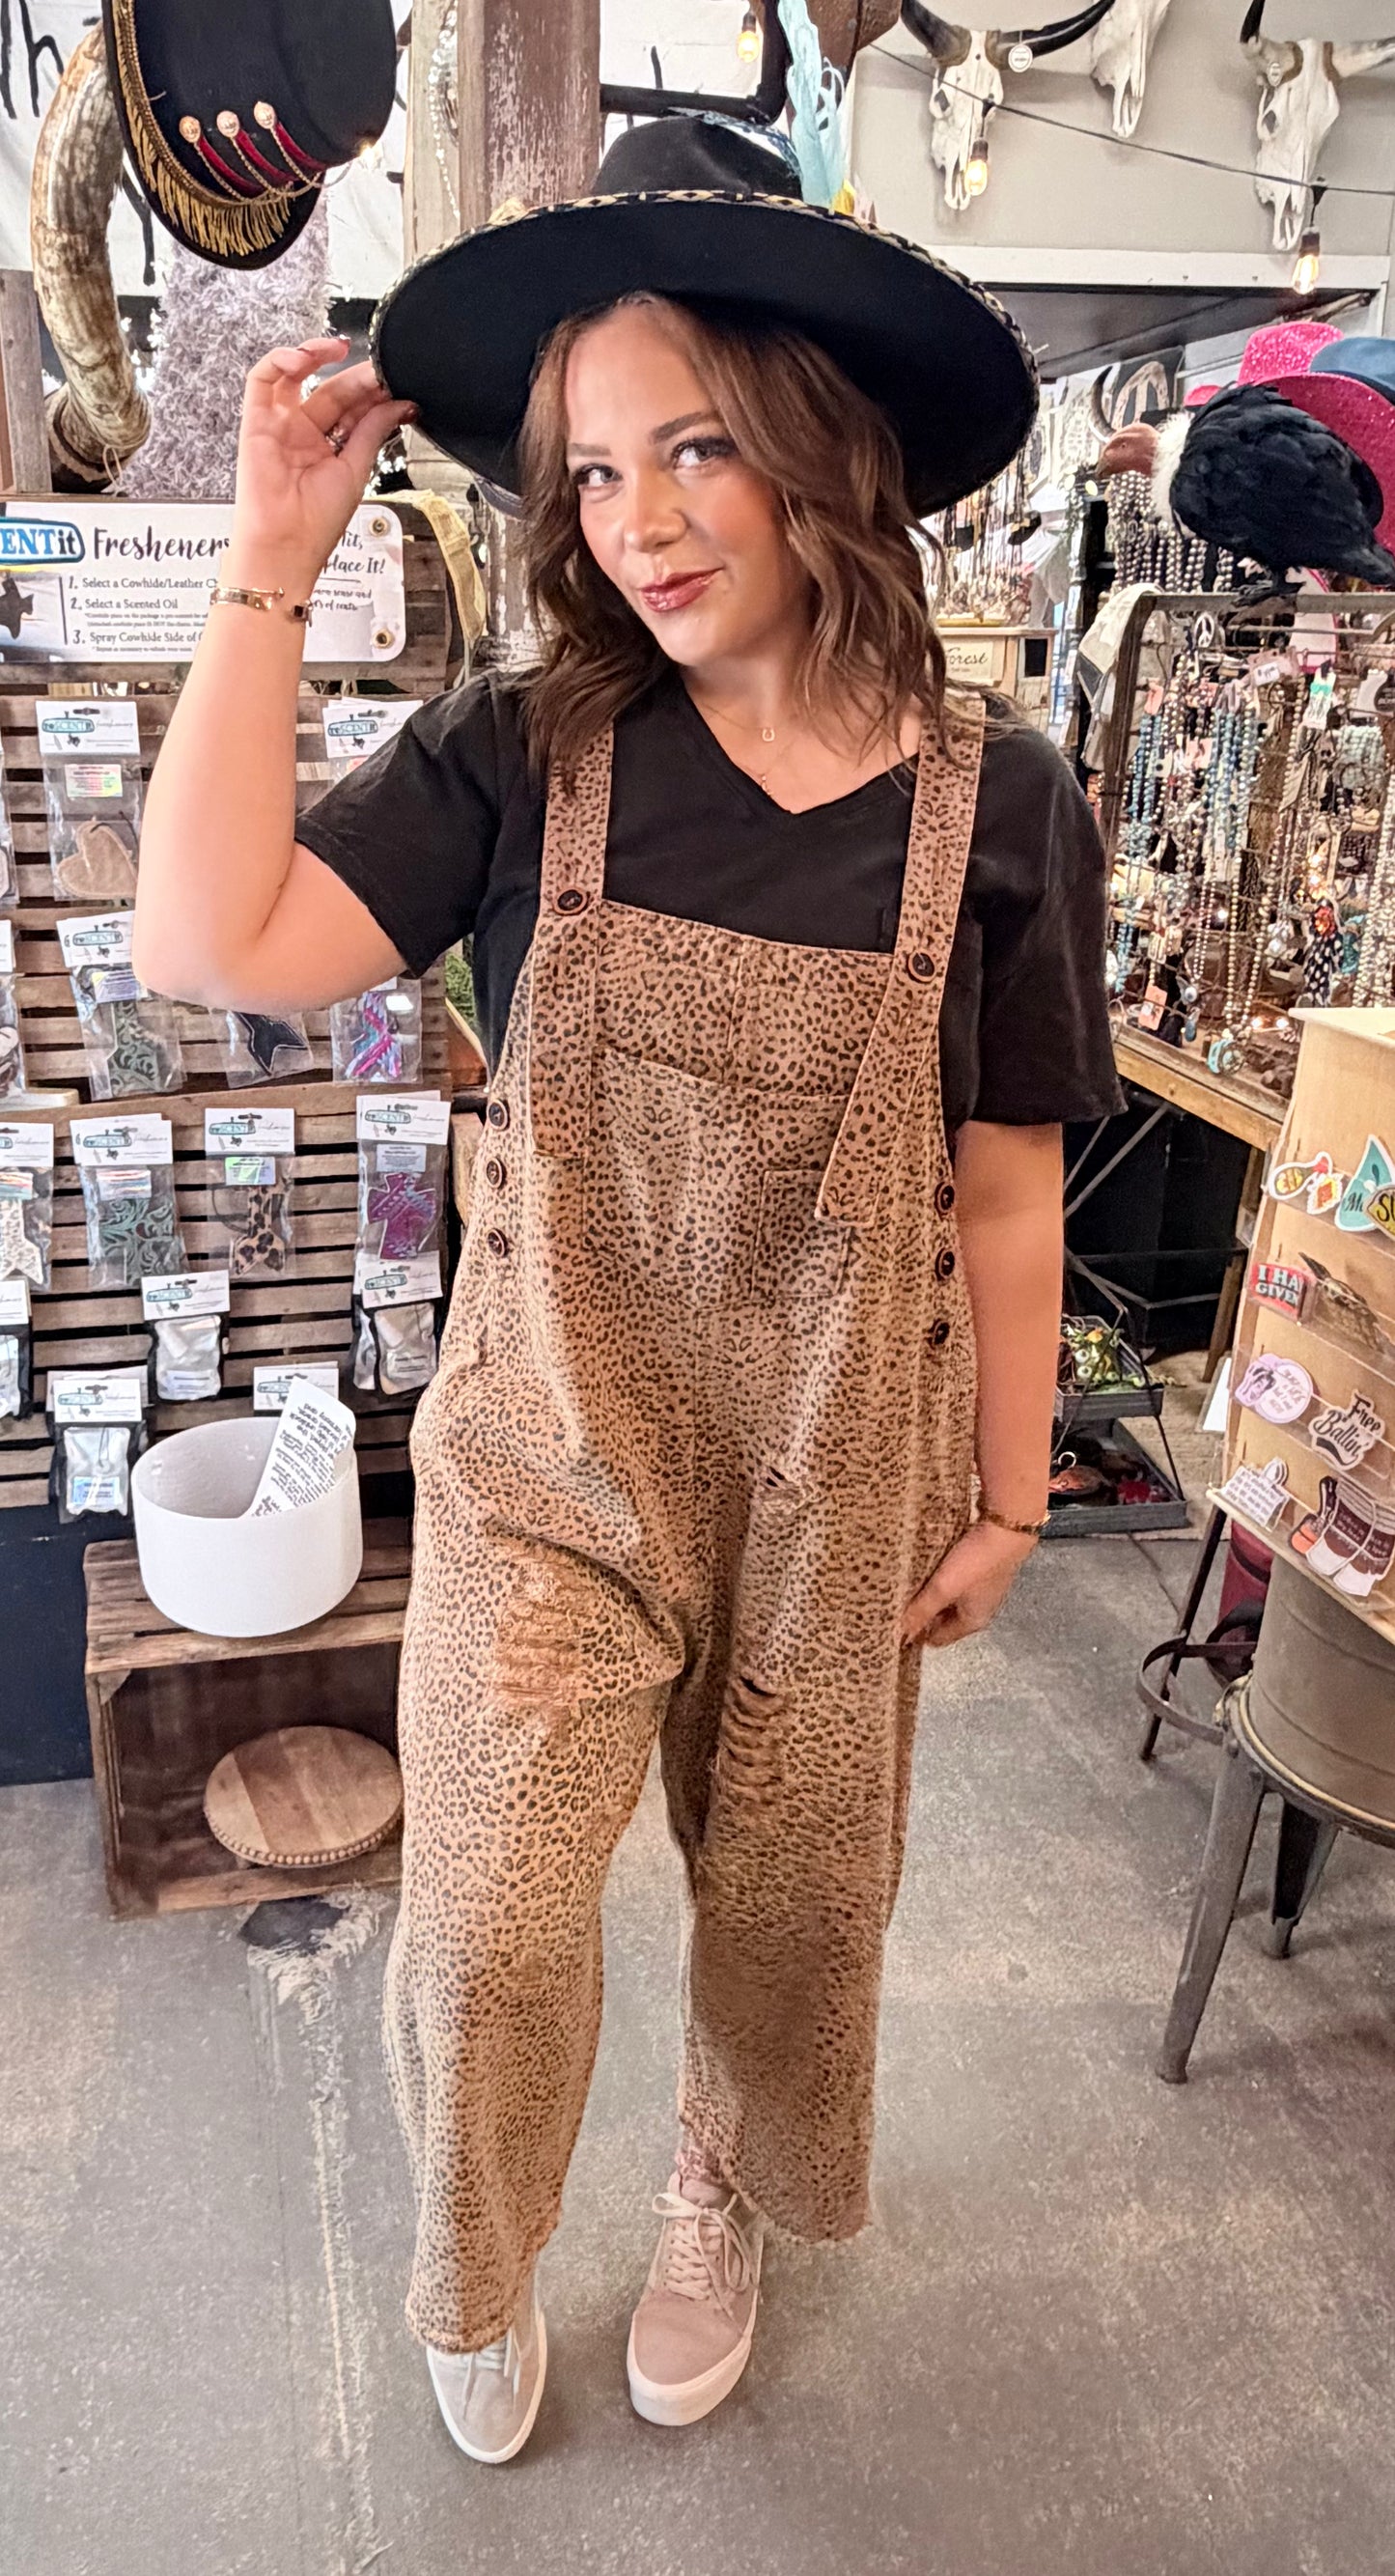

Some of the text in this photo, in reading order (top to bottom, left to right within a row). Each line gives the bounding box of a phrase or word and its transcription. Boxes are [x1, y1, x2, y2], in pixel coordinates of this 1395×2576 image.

[69, 576, 78, 589] 1.
[82, 577, 110, 588] Select
[122, 577, 203, 589] Cowhide/Leather
[70, 598, 82, 610] 2.
[85, 599, 113, 609] Select
[124, 599, 160, 609] Scented
[163, 599, 178, 609] Oil
[72, 630, 197, 644] 3. Spray Cowhide Side of
[1344, 1391, 1381, 1432] Free
[1313, 1410, 1370, 1457] Ballin'
